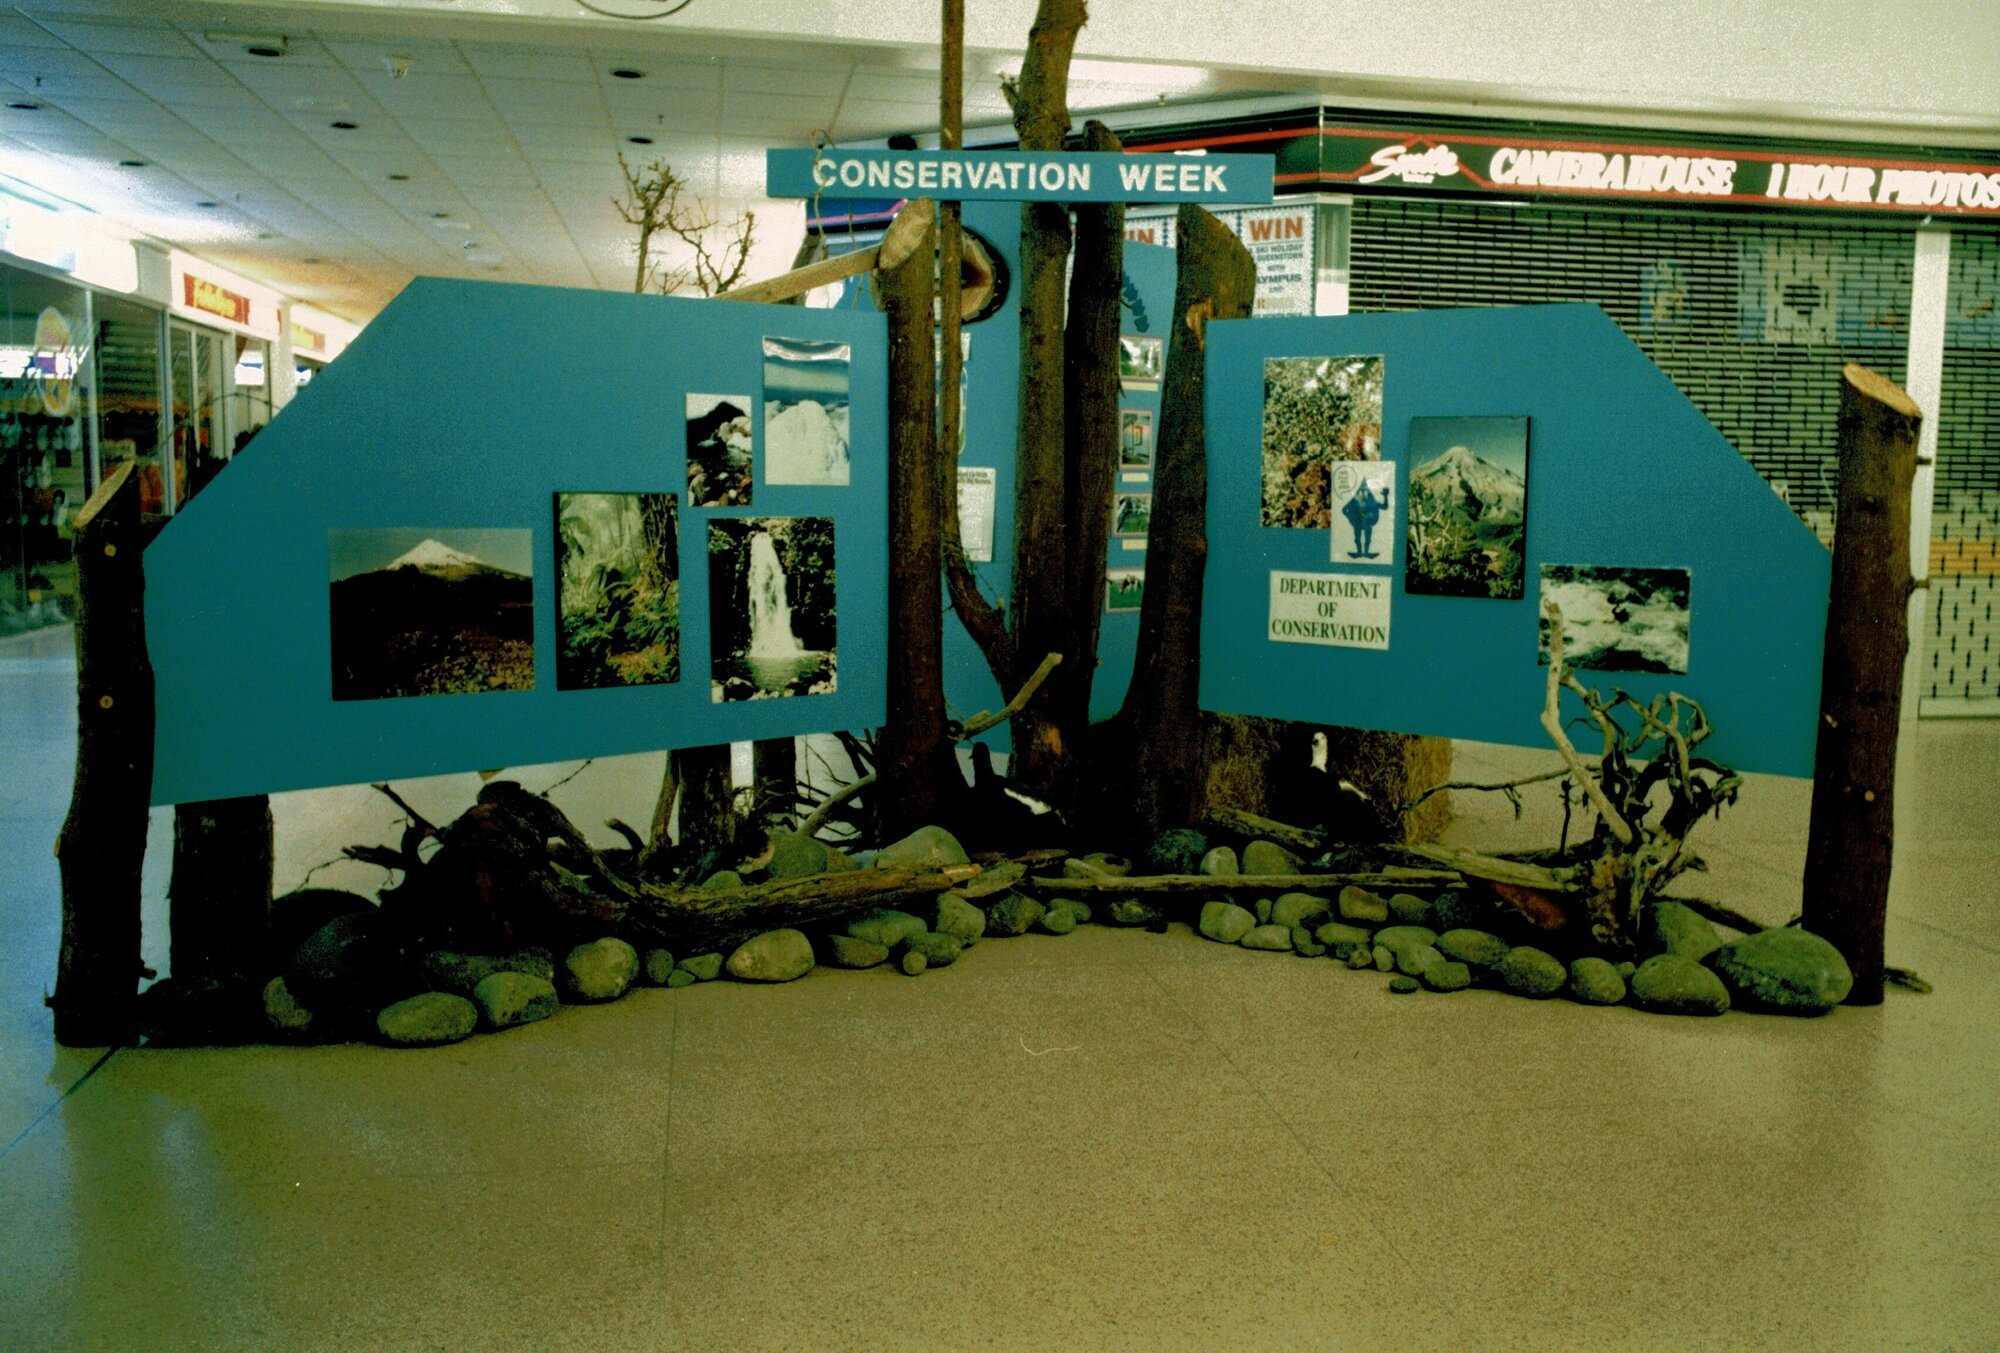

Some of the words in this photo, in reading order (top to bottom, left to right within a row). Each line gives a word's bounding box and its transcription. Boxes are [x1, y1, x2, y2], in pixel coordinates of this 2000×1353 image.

[813, 159, 1091, 192] CONSERVATION
[1119, 163, 1228, 193] WEEK
[1766, 164, 1784, 198] 1
[1785, 163, 1876, 203] HOUR
[1876, 169, 2000, 208] PHOTOS
[1121, 227, 1154, 244] IN
[1249, 216, 1303, 241] WIN
[1256, 273, 1302, 284] LYMPUS
[1280, 577, 1380, 599] DEPARTMENT
[1317, 601, 1338, 618] OF
[1271, 618, 1386, 643] CONSERVATION
